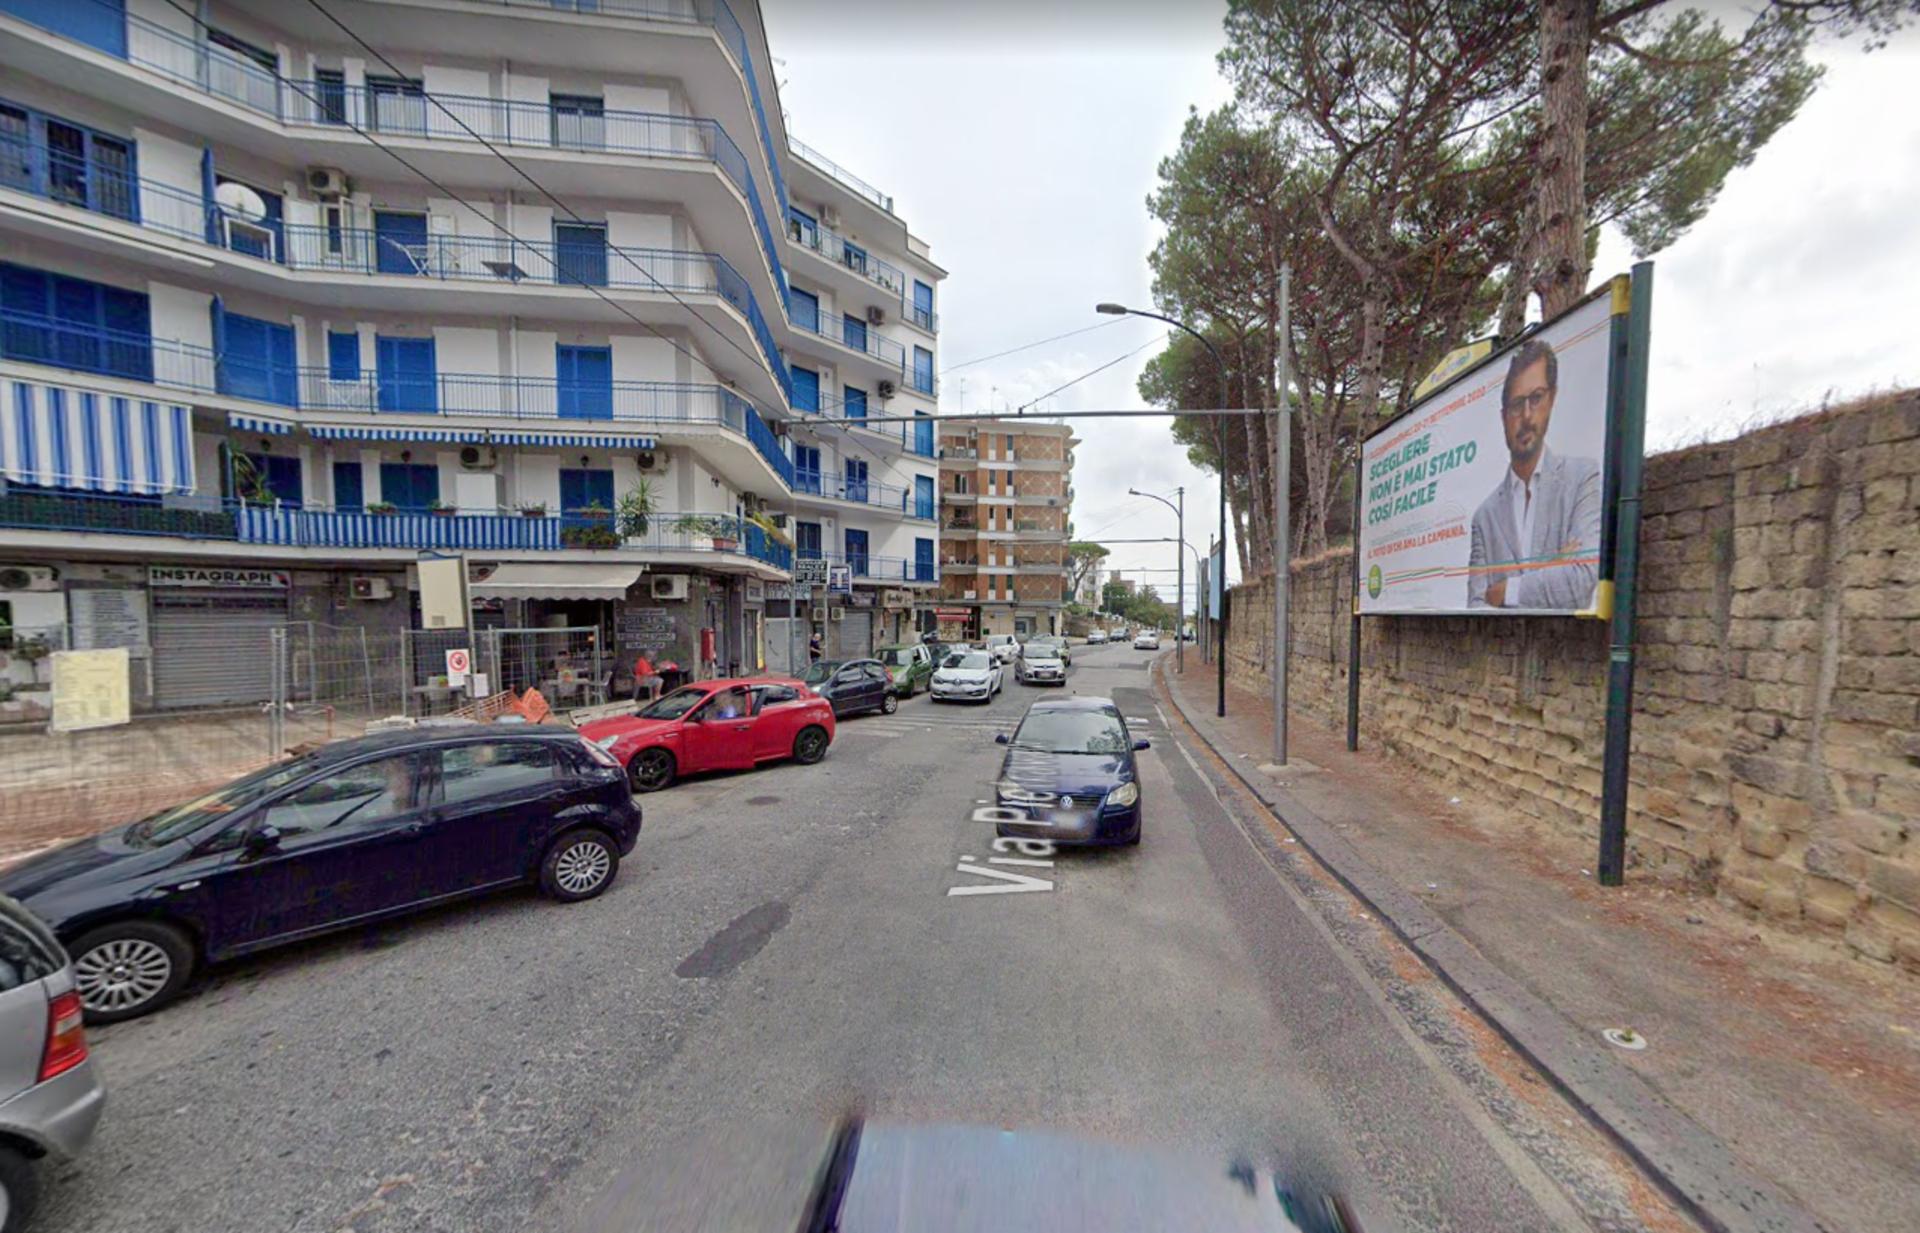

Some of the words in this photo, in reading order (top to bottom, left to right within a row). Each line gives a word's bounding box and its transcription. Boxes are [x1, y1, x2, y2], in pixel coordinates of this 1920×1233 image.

[1369, 433, 1431, 481] SCEGLIERE
[1369, 479, 1393, 503] NON
[1394, 471, 1402, 492] È
[1403, 461, 1428, 488] MAI
[1429, 440, 1477, 477] STATO
[1368, 498, 1393, 525] COSÌ
[1393, 481, 1438, 517] FACILE
[151, 569, 272, 582] INSTAGRAPH
